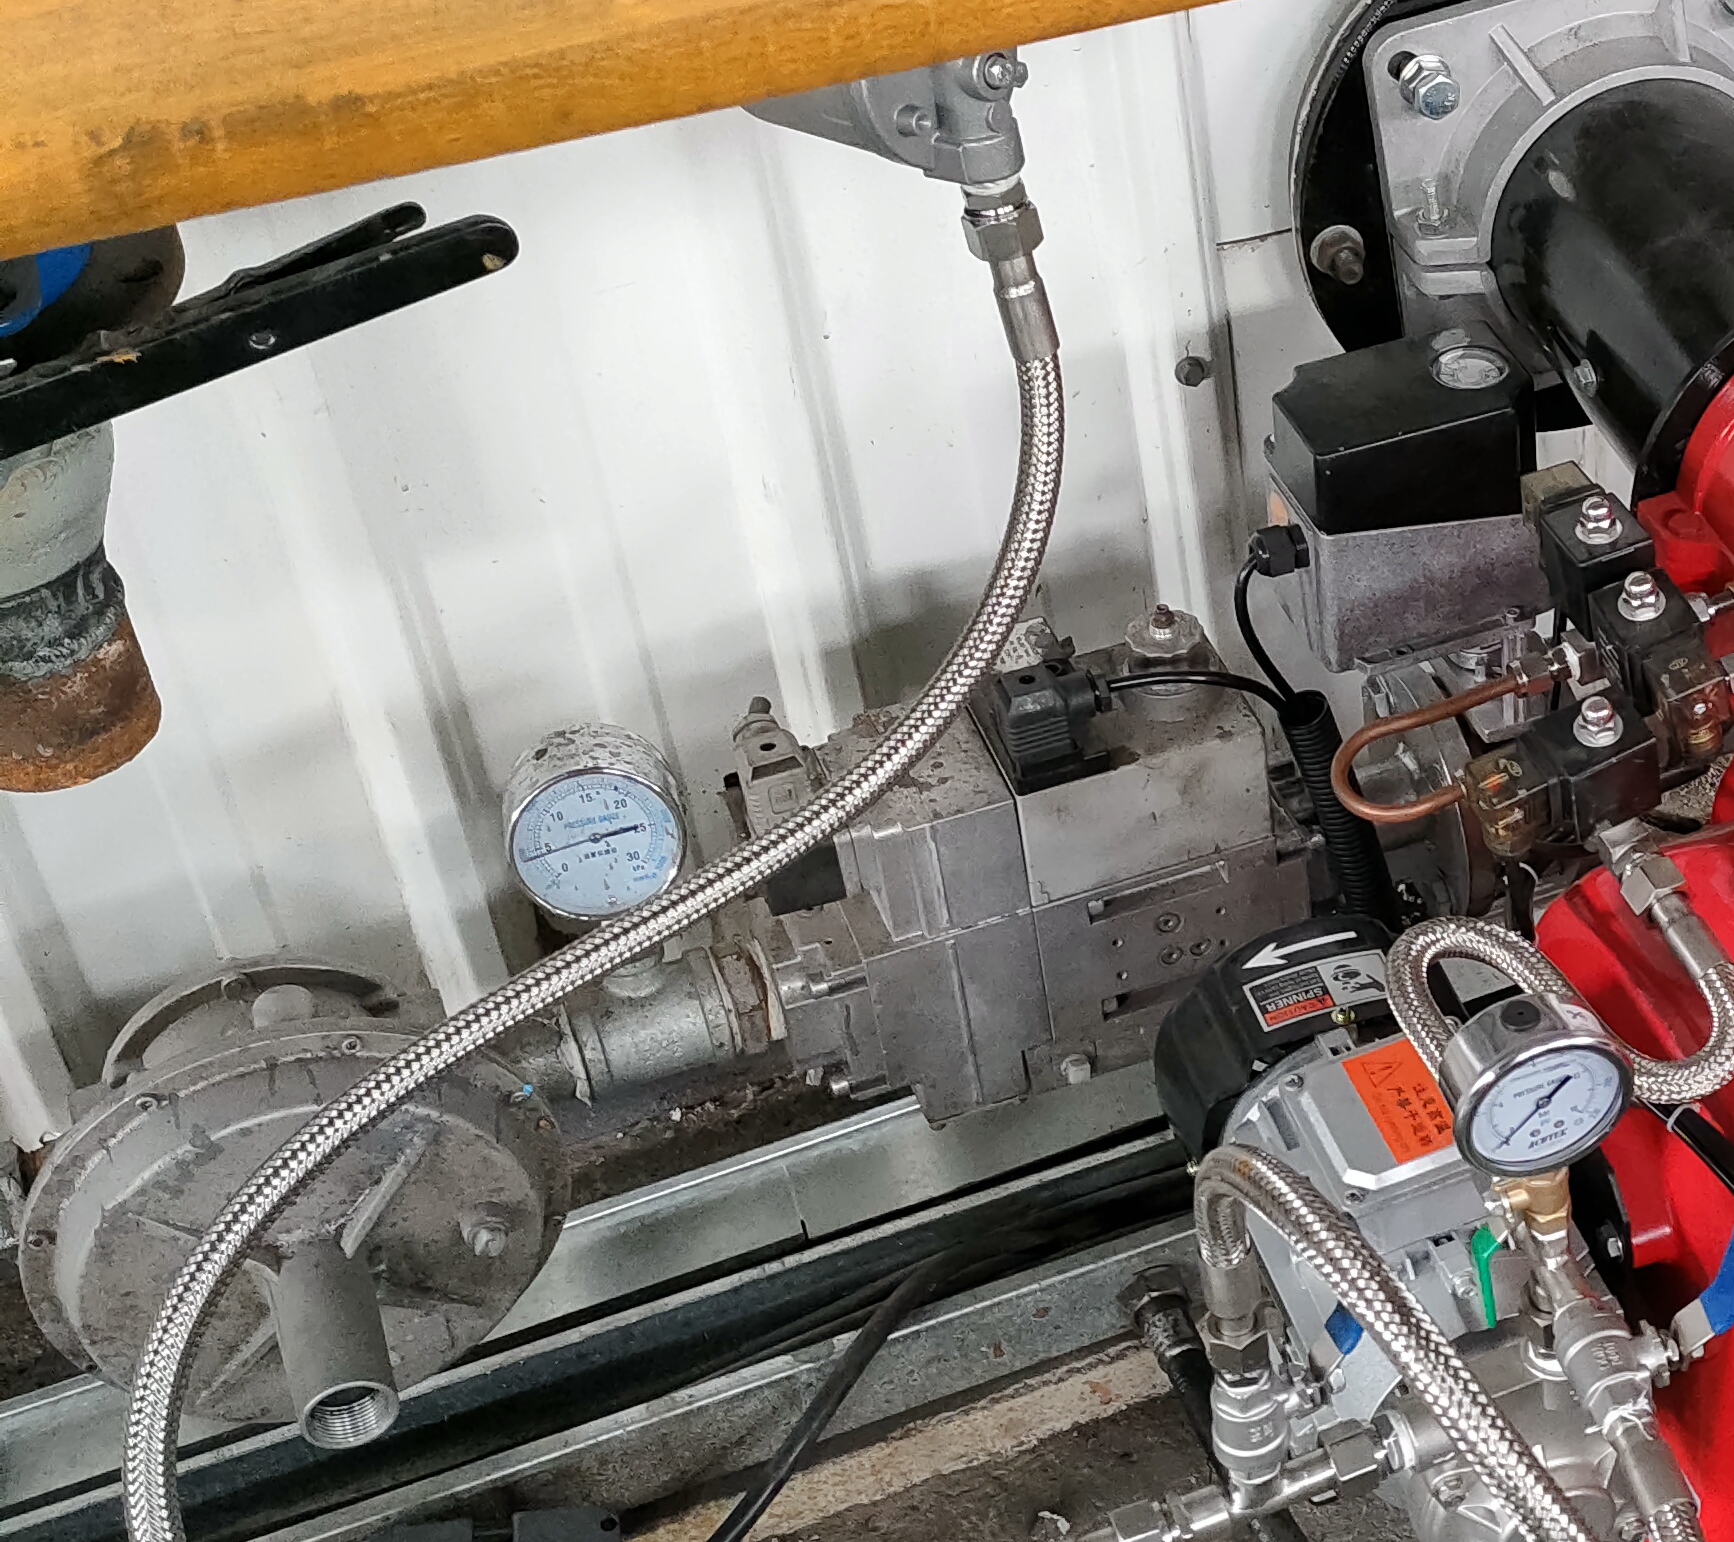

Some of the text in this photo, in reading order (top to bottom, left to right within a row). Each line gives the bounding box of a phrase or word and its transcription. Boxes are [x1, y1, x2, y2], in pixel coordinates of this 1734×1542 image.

[579, 793, 593, 804] 15
[613, 798, 627, 809] 20
[550, 811, 563, 823] 10
[544, 843, 552, 853] 5
[626, 850, 640, 862] 30
[561, 862, 569, 872] 0
[1265, 986, 1324, 1012] SPINNER
